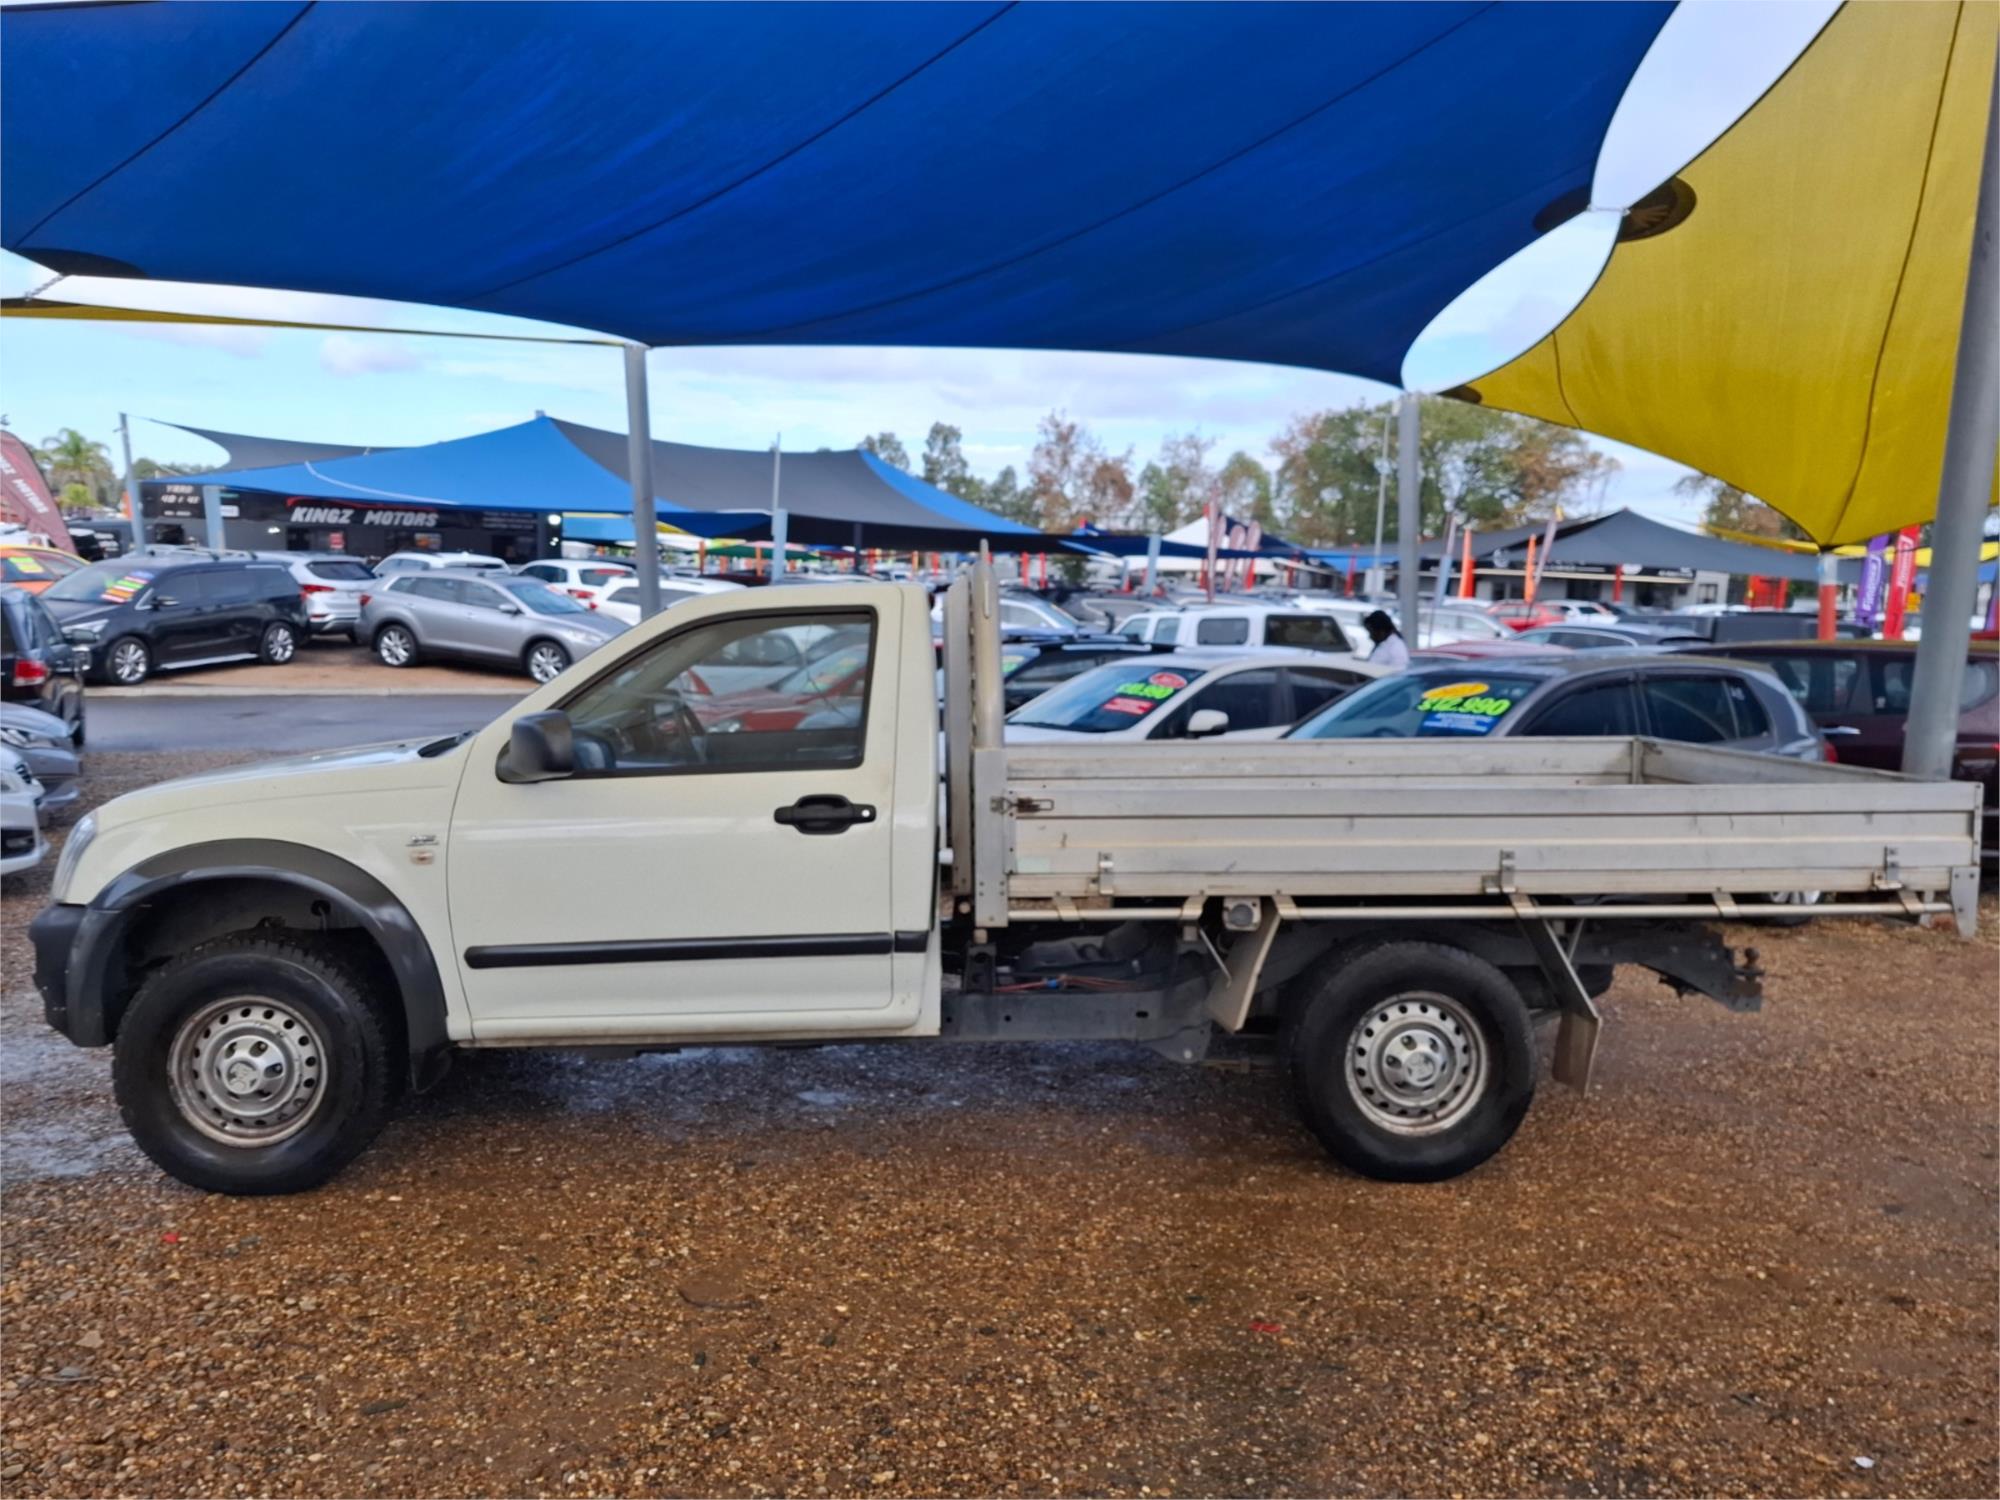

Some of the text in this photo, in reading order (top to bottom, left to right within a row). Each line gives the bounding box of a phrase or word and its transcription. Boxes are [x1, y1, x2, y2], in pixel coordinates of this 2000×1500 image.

[12, 478, 49, 513] MOTORS
[291, 506, 439, 527] KINGZ MOTORS
